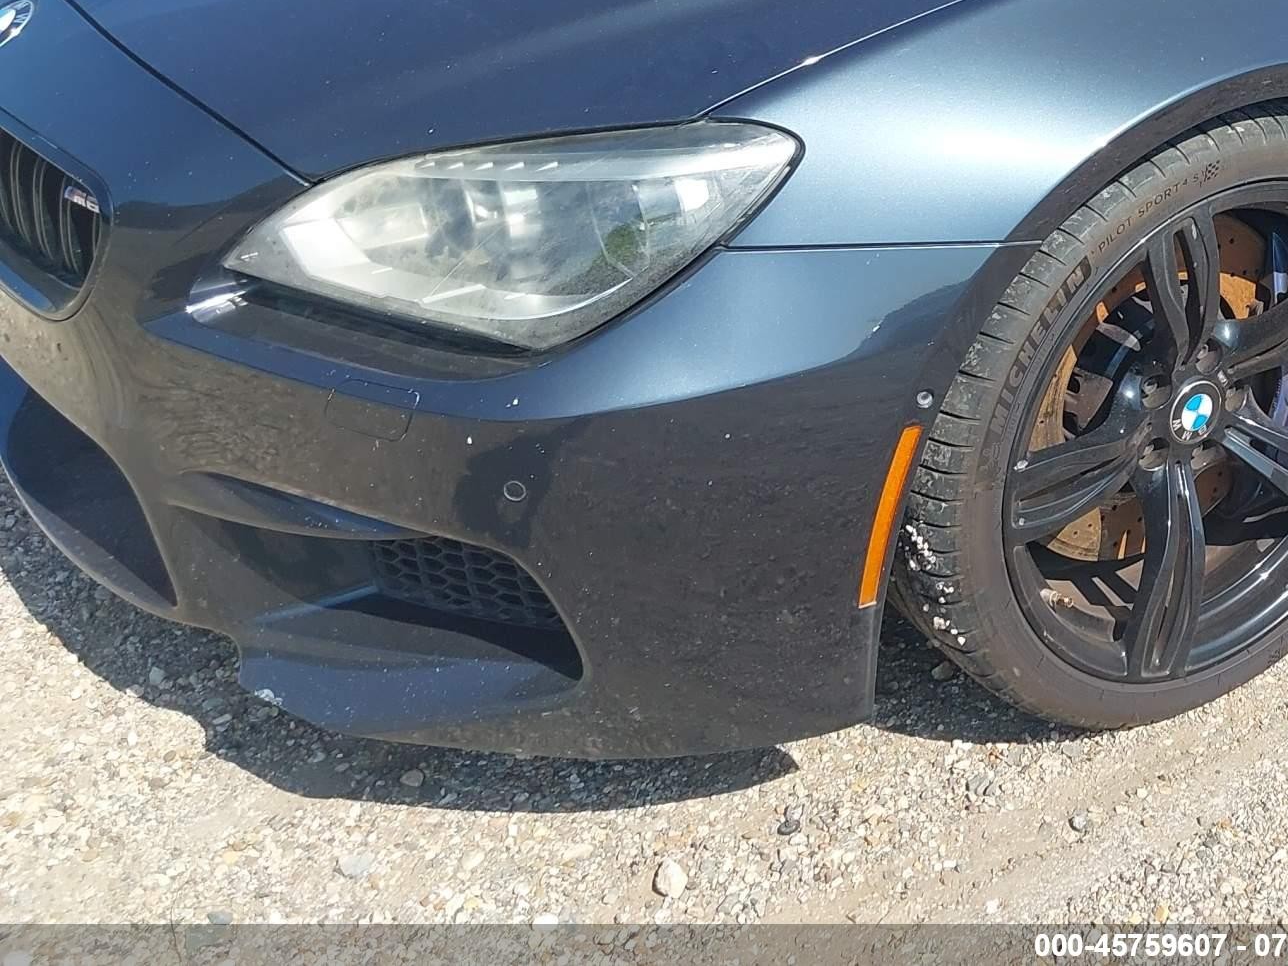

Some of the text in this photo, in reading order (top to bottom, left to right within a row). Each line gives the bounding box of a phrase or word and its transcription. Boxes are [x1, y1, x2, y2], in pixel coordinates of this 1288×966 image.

[1097, 215, 1134, 253] PILOT
[1137, 182, 1182, 218] SPORT
[988, 256, 1091, 435] MICHELIN
